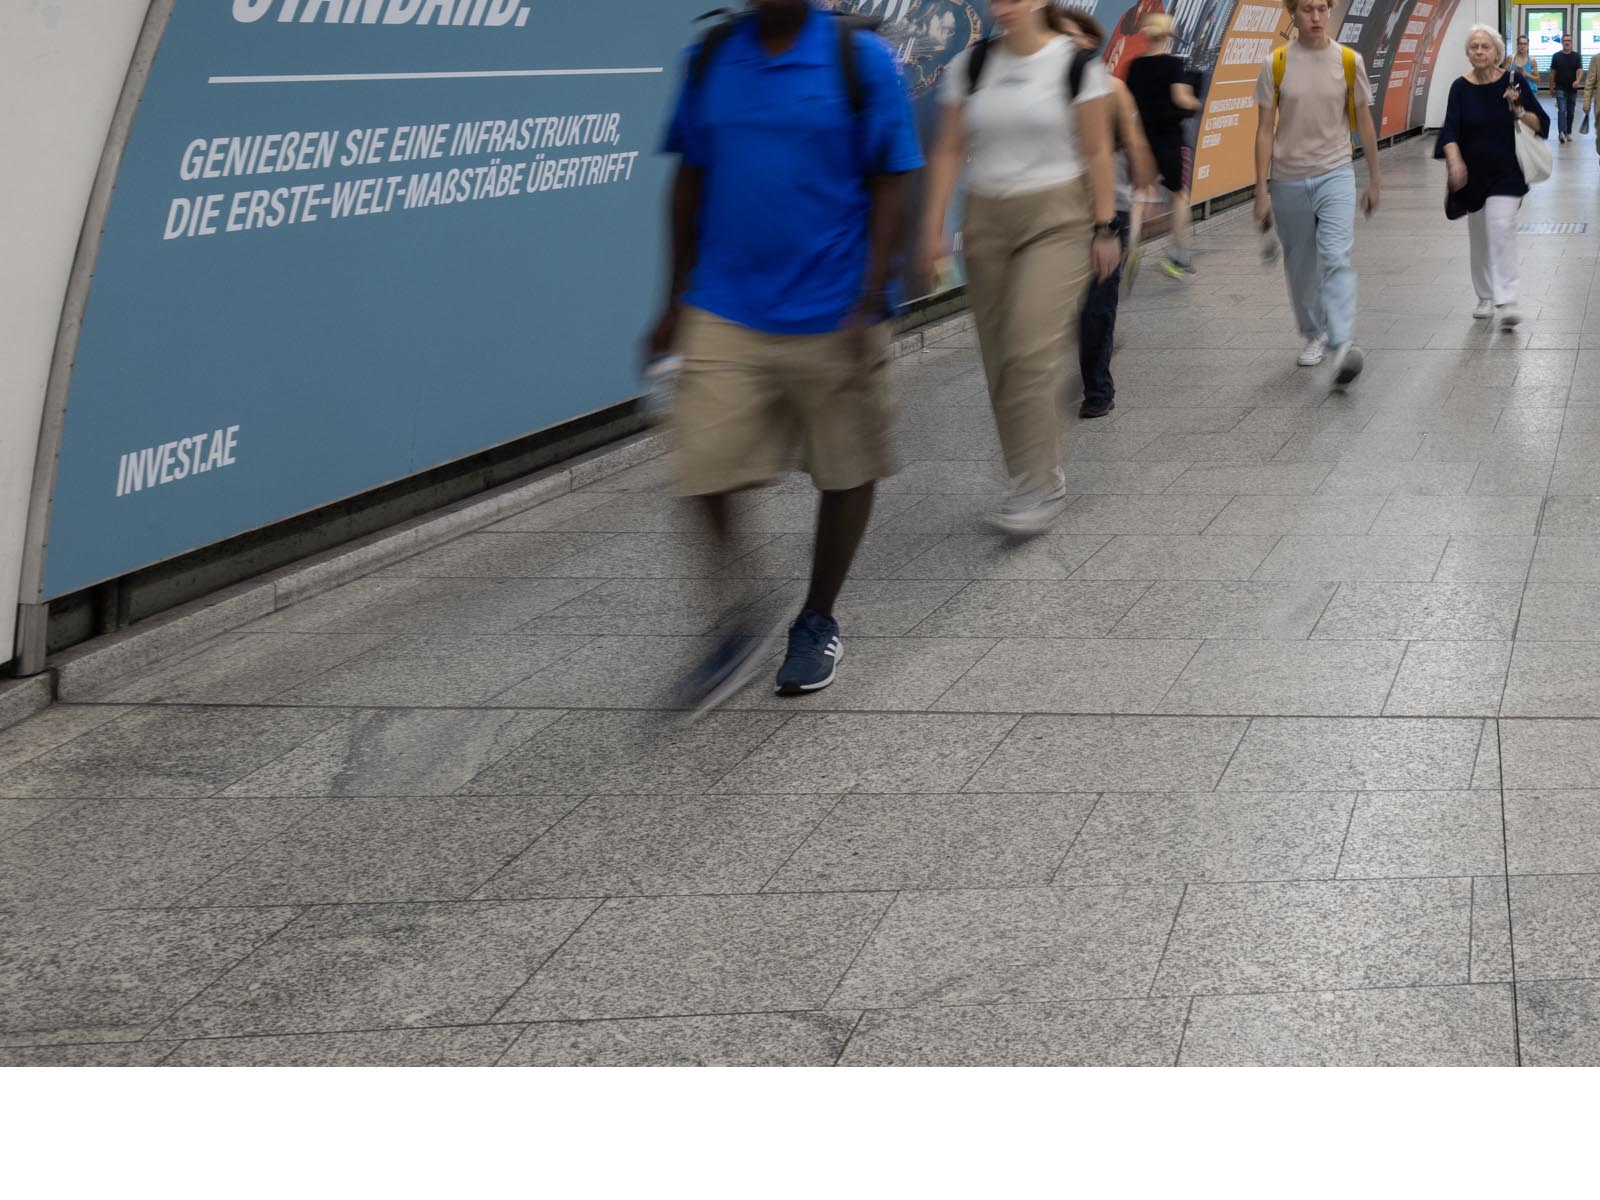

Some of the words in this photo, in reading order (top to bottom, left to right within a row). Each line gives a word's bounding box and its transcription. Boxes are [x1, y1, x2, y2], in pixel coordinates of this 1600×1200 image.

[180, 130, 338, 181] GENIEßEN
[340, 127, 389, 167] SIE
[388, 123, 450, 162] EINE
[449, 112, 621, 156] INFRASTRUKTUR,
[163, 194, 225, 240] DIE
[526, 150, 639, 193] ÜBERTRIFFT
[116, 425, 239, 497] INVEST.AE
